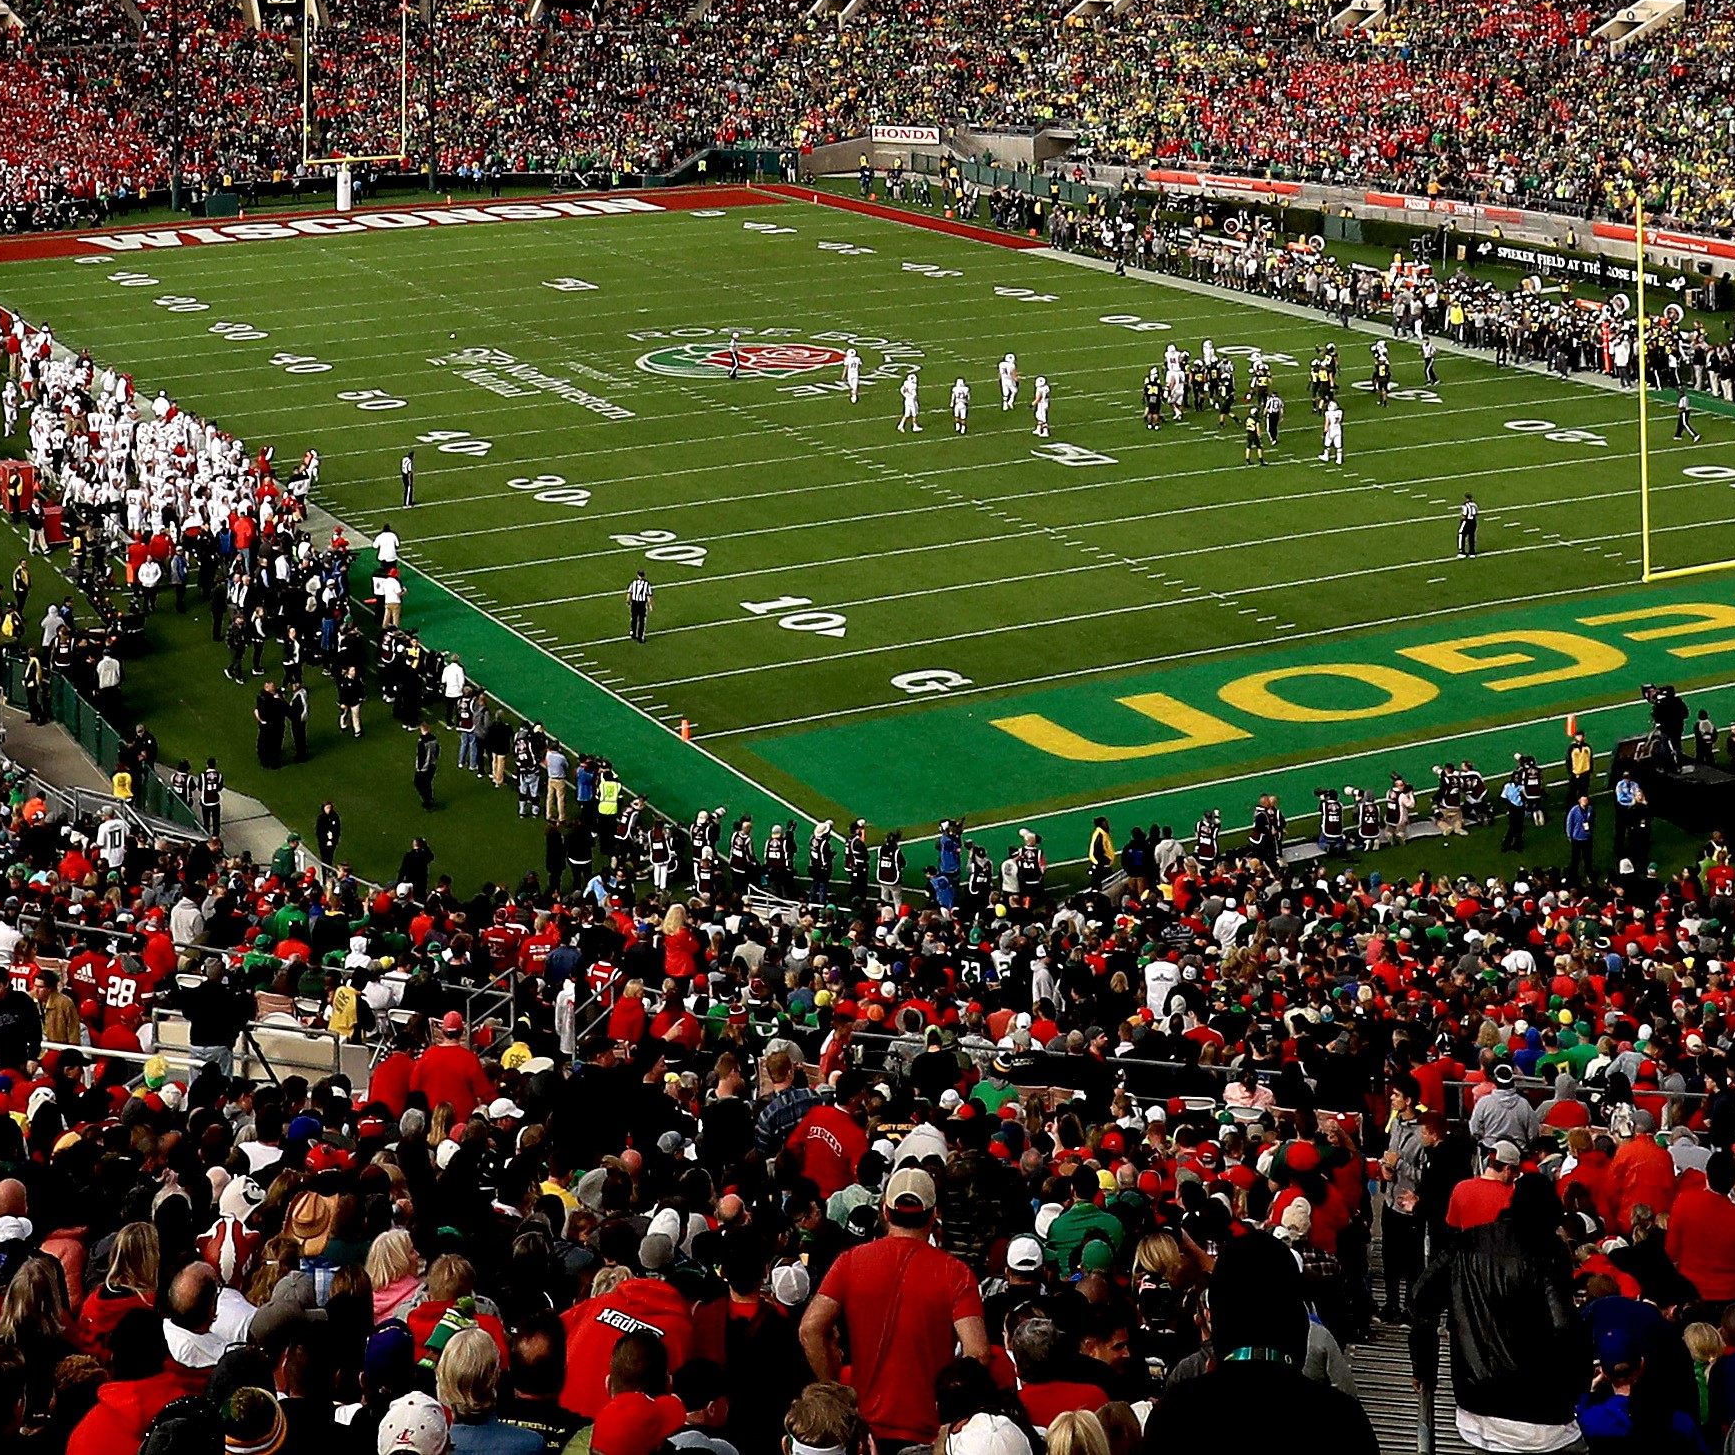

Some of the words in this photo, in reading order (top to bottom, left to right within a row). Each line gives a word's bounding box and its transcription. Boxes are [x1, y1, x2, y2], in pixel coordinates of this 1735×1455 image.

[873, 128, 937, 141] HONDA
[77, 198, 667, 251] WISCONSIN
[1537, 253, 1565, 269] FIELD
[1567, 259, 1583, 271] AT
[207, 321, 270, 342] 30
[268, 351, 334, 374] 40
[336, 388, 409, 411] 50
[416, 429, 493, 454] 40
[506, 474, 593, 503] 30
[608, 529, 709, 564] 20
[739, 594, 848, 633] 10
[889, 668, 974, 694] G
[106, 976, 136, 1008] 28
